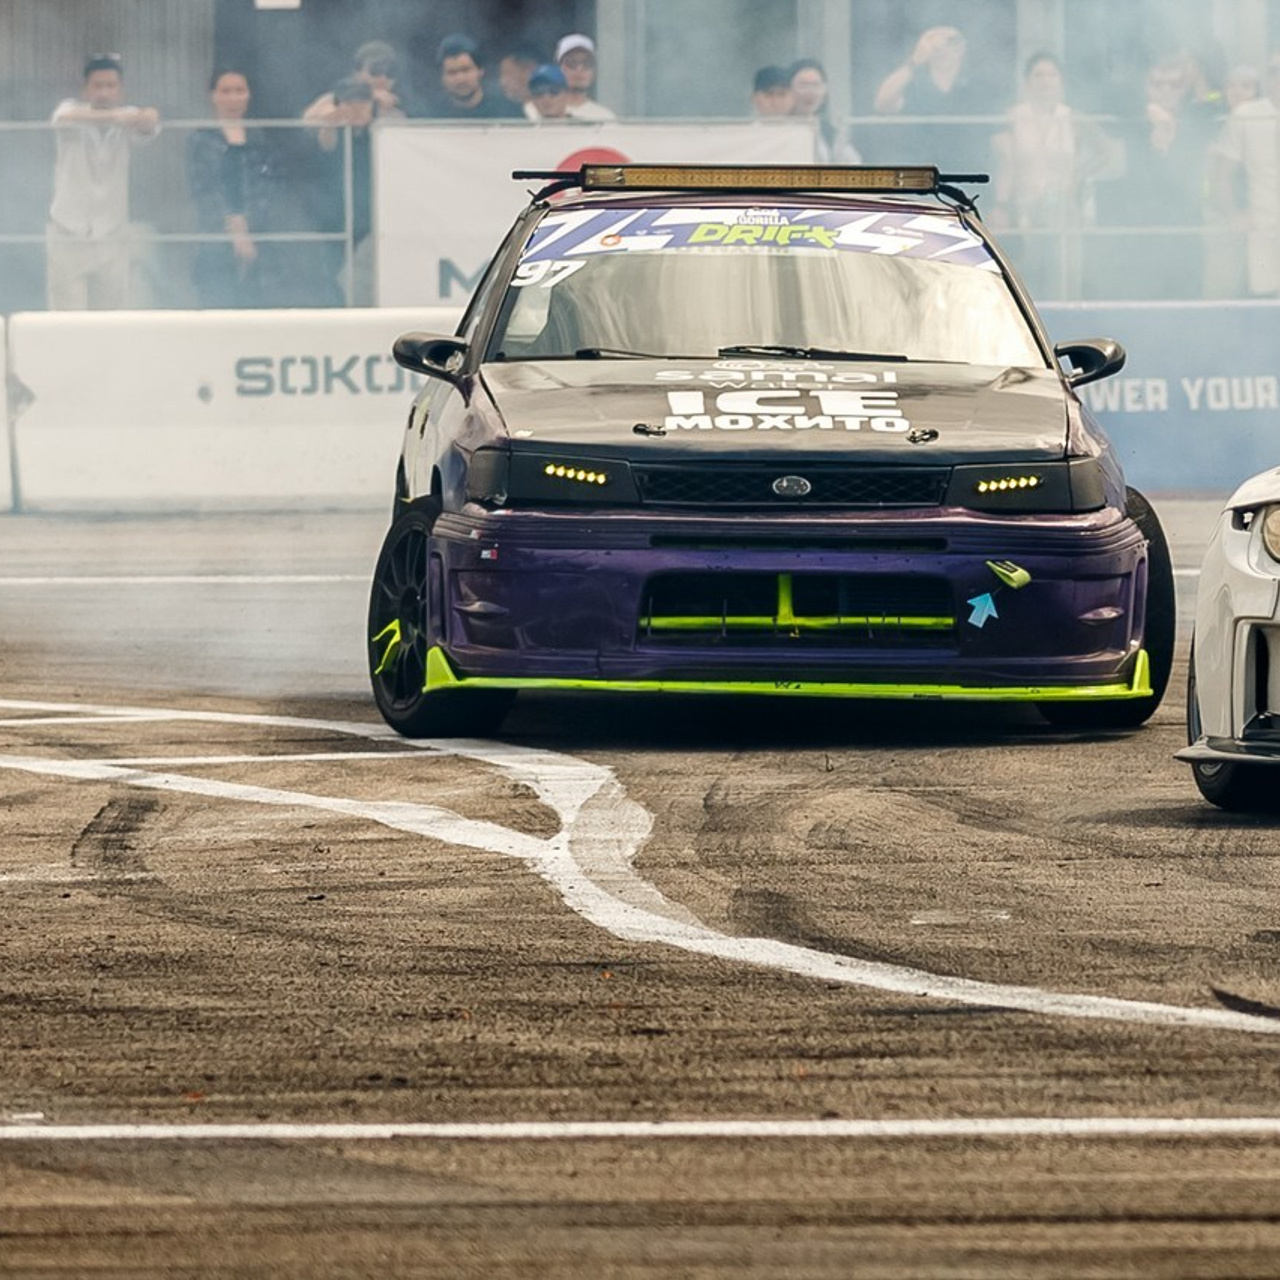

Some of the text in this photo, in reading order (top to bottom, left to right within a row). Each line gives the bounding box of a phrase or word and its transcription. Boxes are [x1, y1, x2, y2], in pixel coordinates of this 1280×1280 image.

[737, 215, 789, 226] GORILLA
[687, 223, 841, 248] DRIFT
[511, 260, 587, 288] 97
[655, 370, 898, 384] samal
[667, 389, 903, 416] ICE
[1078, 376, 1169, 412] WER
[1182, 376, 1280, 411] YOUR
[664, 415, 911, 433] МОХИТО
